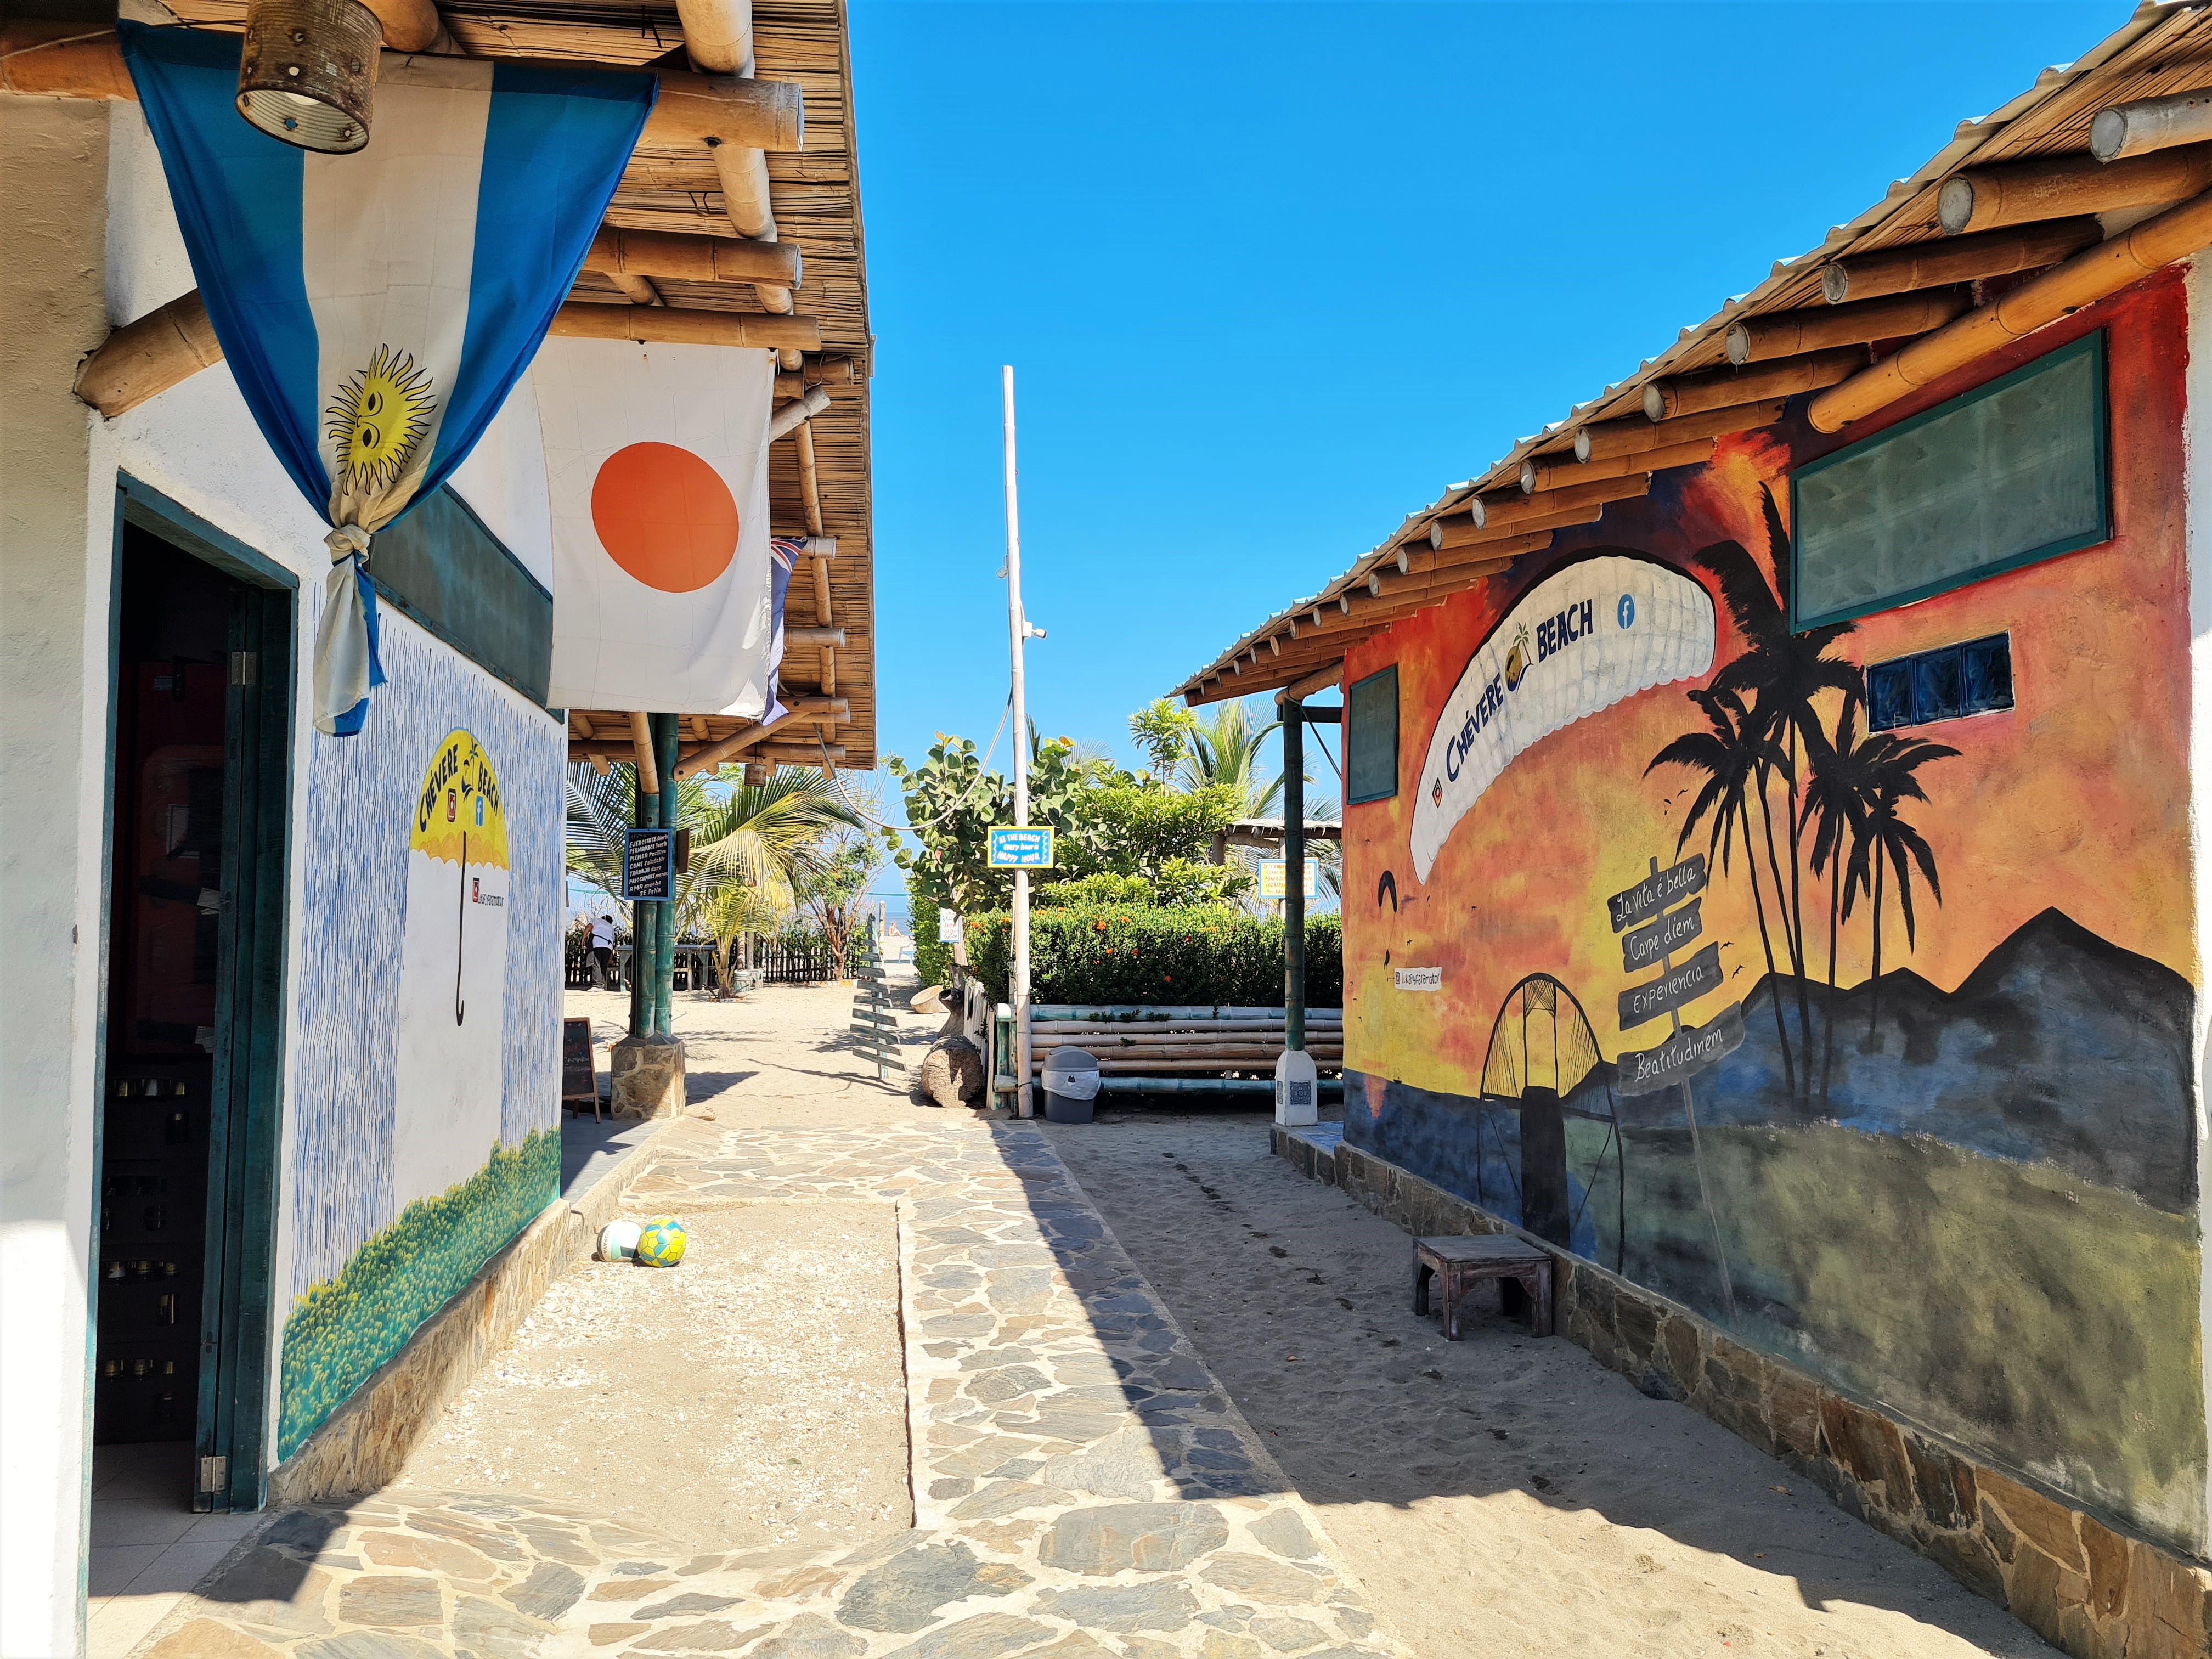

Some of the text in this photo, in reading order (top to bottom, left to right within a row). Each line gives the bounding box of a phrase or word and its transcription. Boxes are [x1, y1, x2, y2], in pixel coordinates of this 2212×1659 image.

[1536, 599, 1593, 663] BEACH
[478, 760, 499, 817] BEACH
[629, 836, 656, 848] EJERCITATE
[998, 833, 1041, 844] AT THE BEACH
[629, 843, 655, 854] PERMANECE
[629, 853, 648, 862] PIENSA
[997, 851, 1040, 864] HAPPY HOUR
[629, 861, 644, 870] COME
[629, 883, 644, 893] AMA
[1616, 893, 1633, 922] La
[1632, 882, 1655, 911] vita
[1666, 865, 1696, 895] bella
[1630, 916, 1695, 960] Carpe diem
[1634, 1028, 1723, 1082] Beatitudinem
